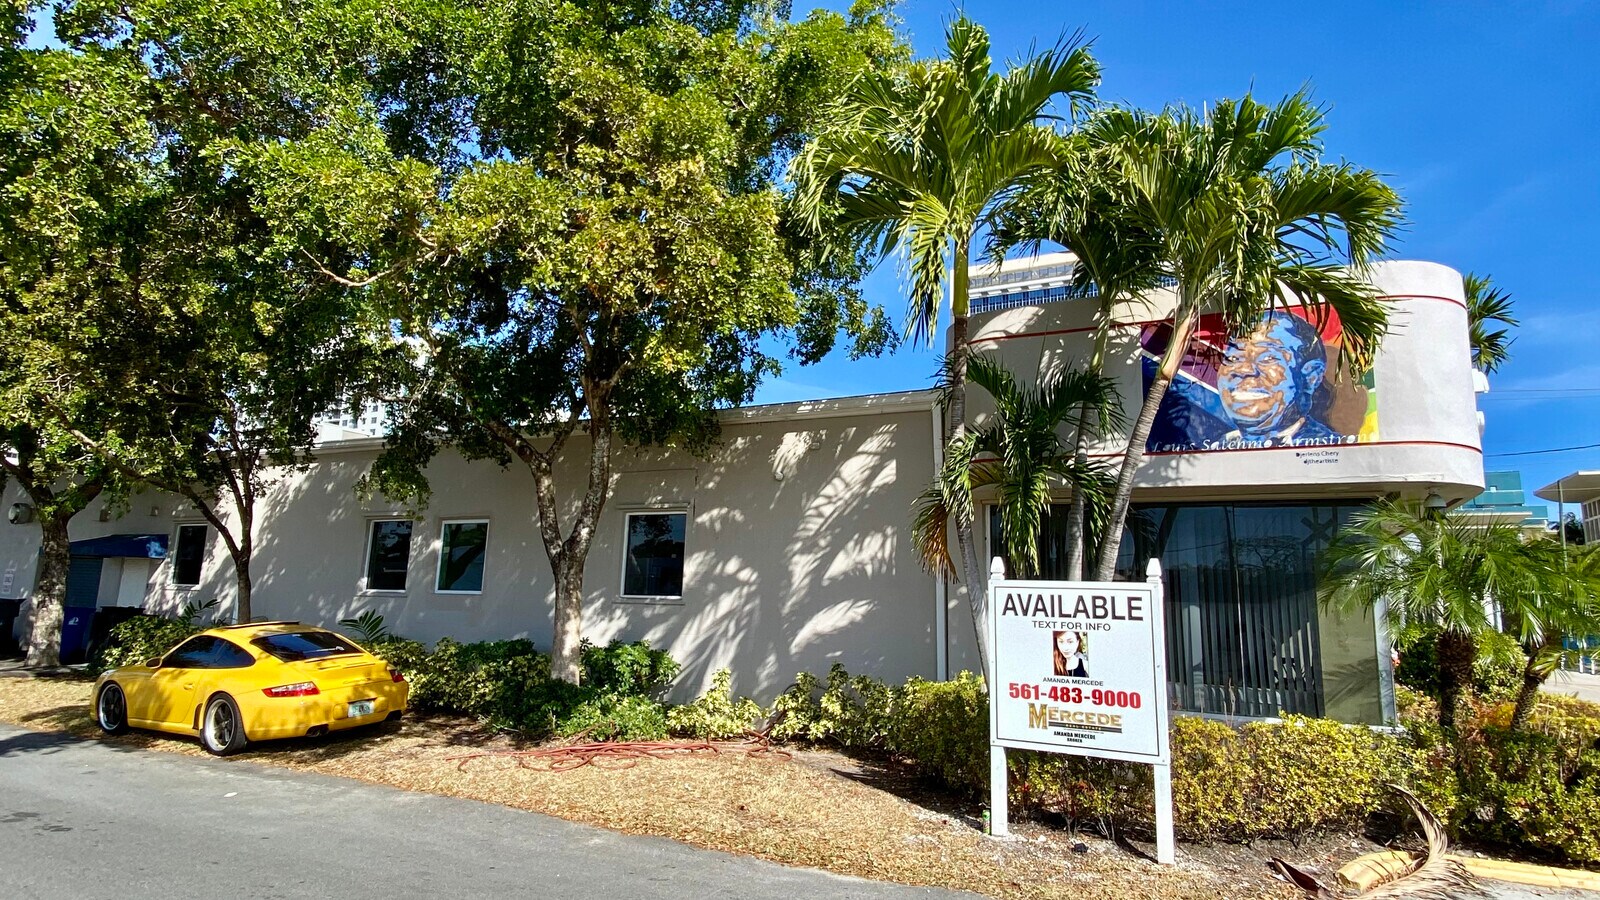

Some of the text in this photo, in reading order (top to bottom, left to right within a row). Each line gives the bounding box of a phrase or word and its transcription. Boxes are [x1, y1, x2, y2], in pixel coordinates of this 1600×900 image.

[1002, 593, 1144, 621] AVAILABLE
[1032, 620, 1111, 632] TEXT FOR INFO
[1072, 679, 1104, 687] MERCEDE
[1009, 682, 1141, 709] 561-483-9000
[1028, 702, 1122, 730] MERCEDE
[1054, 730, 1073, 738] AMANDA
[1074, 732, 1096, 740] MERCEDE
